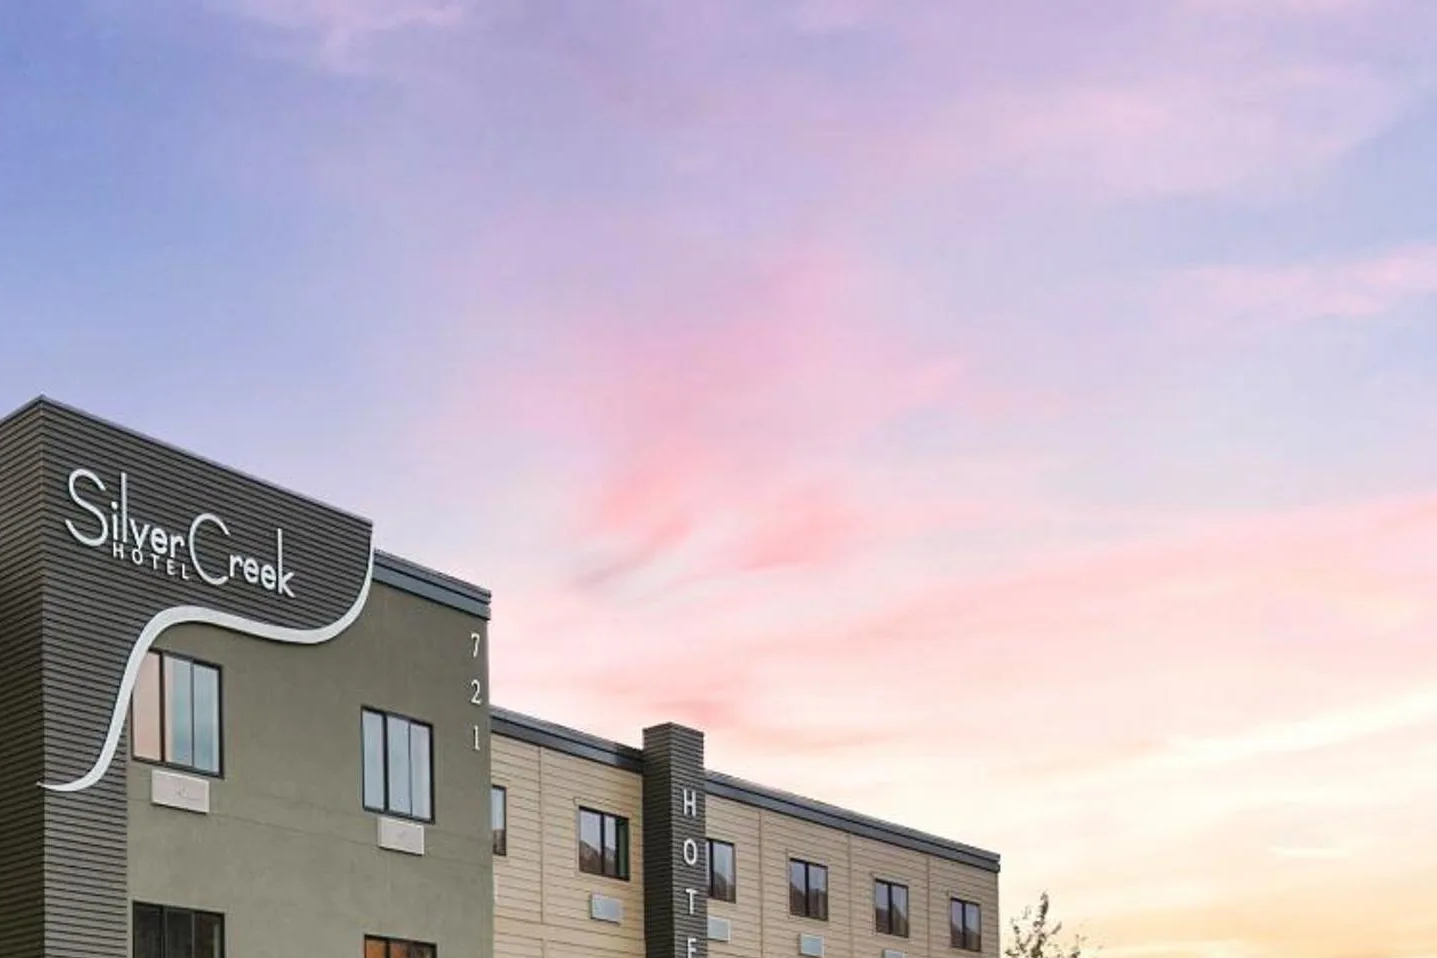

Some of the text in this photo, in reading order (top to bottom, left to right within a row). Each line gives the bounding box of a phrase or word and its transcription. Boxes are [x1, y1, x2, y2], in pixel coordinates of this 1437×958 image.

[65, 468, 296, 598] Silver Creek
[112, 541, 189, 580] HOTEL
[470, 632, 482, 751] 721
